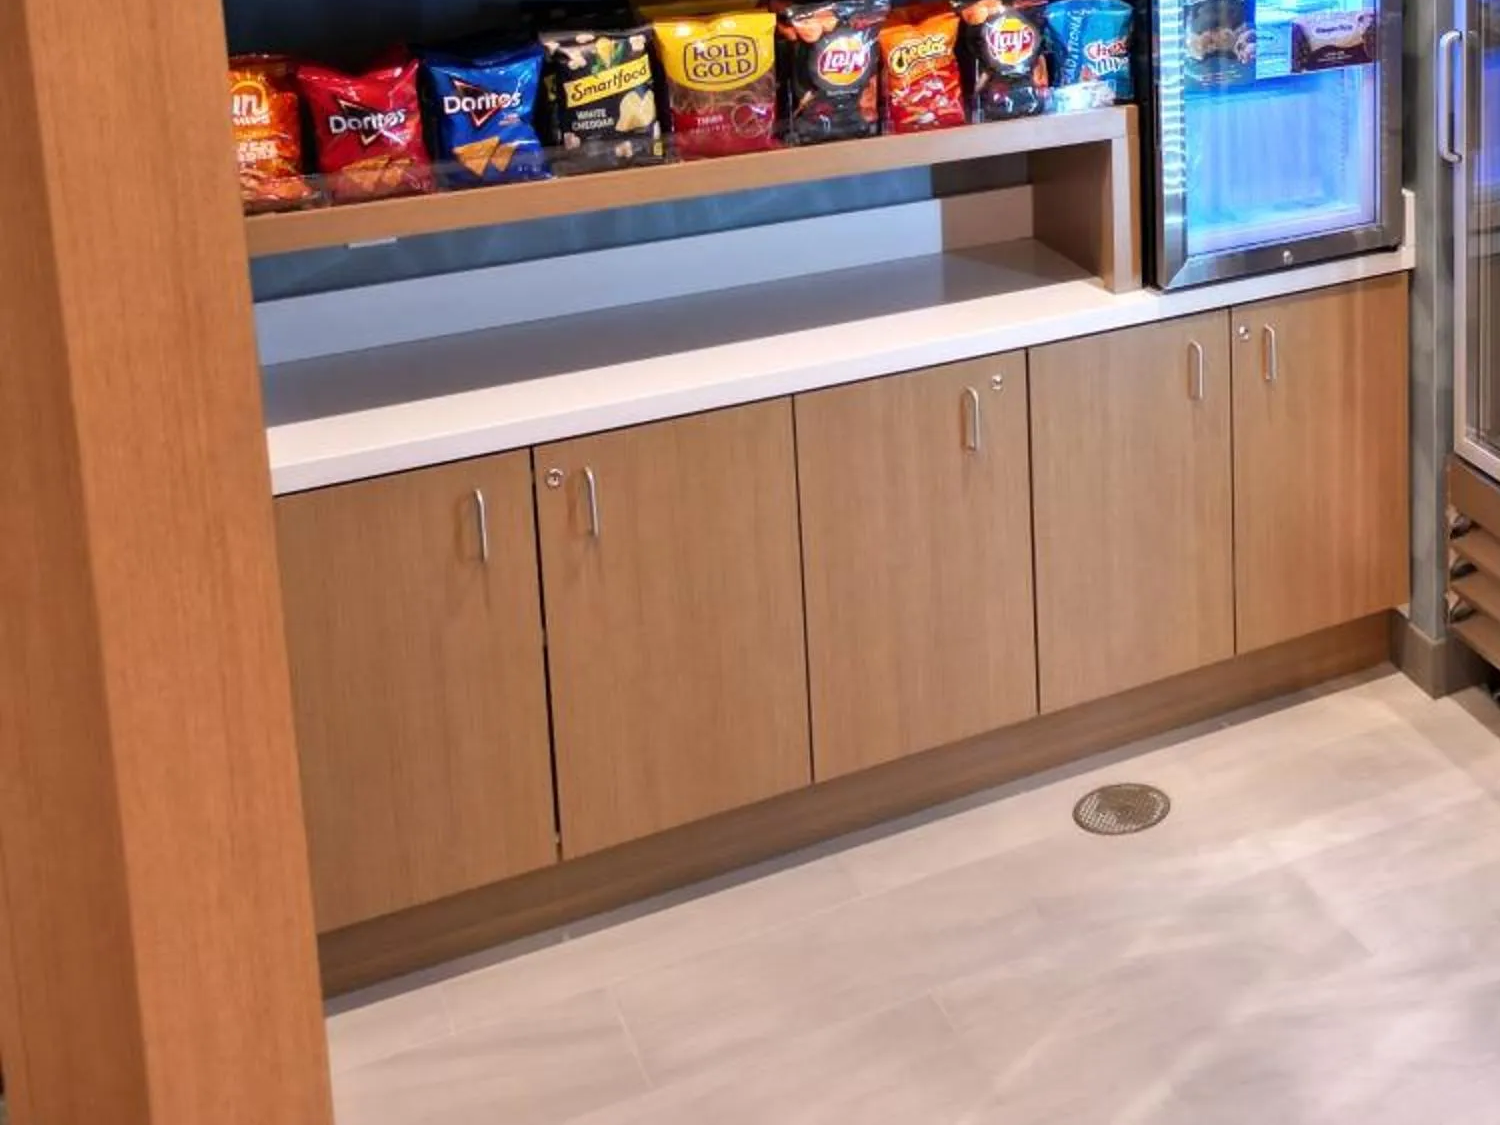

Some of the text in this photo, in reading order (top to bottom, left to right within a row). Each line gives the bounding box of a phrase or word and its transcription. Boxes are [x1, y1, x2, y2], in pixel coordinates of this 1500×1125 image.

[692, 41, 751, 61] ROLD
[692, 58, 752, 78] GOLD
[571, 65, 648, 102] Smartfood
[443, 91, 522, 115] Doritos
[575, 108, 607, 120] WHITE
[328, 107, 407, 135] Doritos
